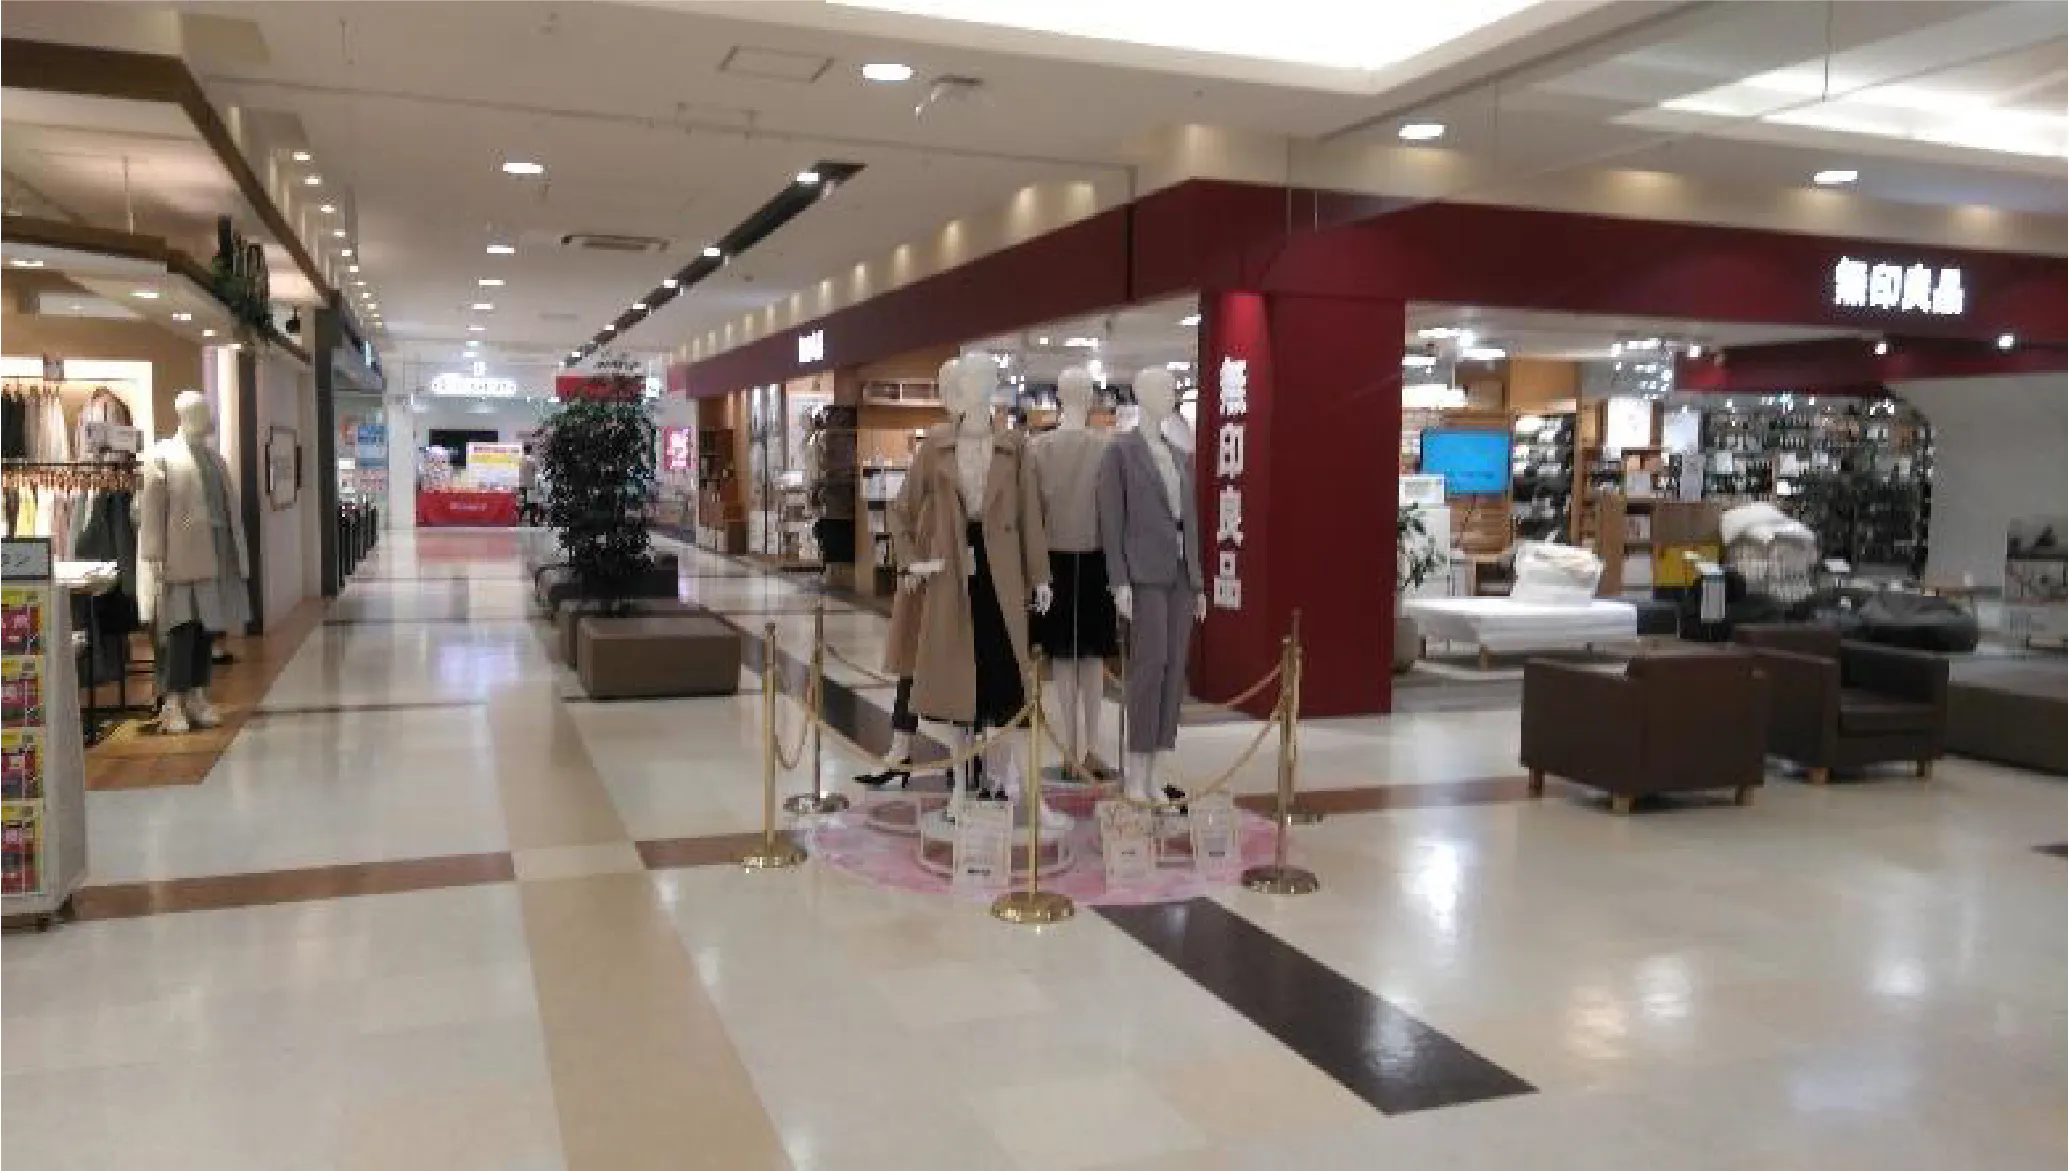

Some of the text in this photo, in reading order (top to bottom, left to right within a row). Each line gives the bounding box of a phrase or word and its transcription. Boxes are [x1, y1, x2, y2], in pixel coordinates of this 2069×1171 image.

[1833, 256, 1966, 315] 無印良品
[1213, 355, 1248, 611] 無印良品
